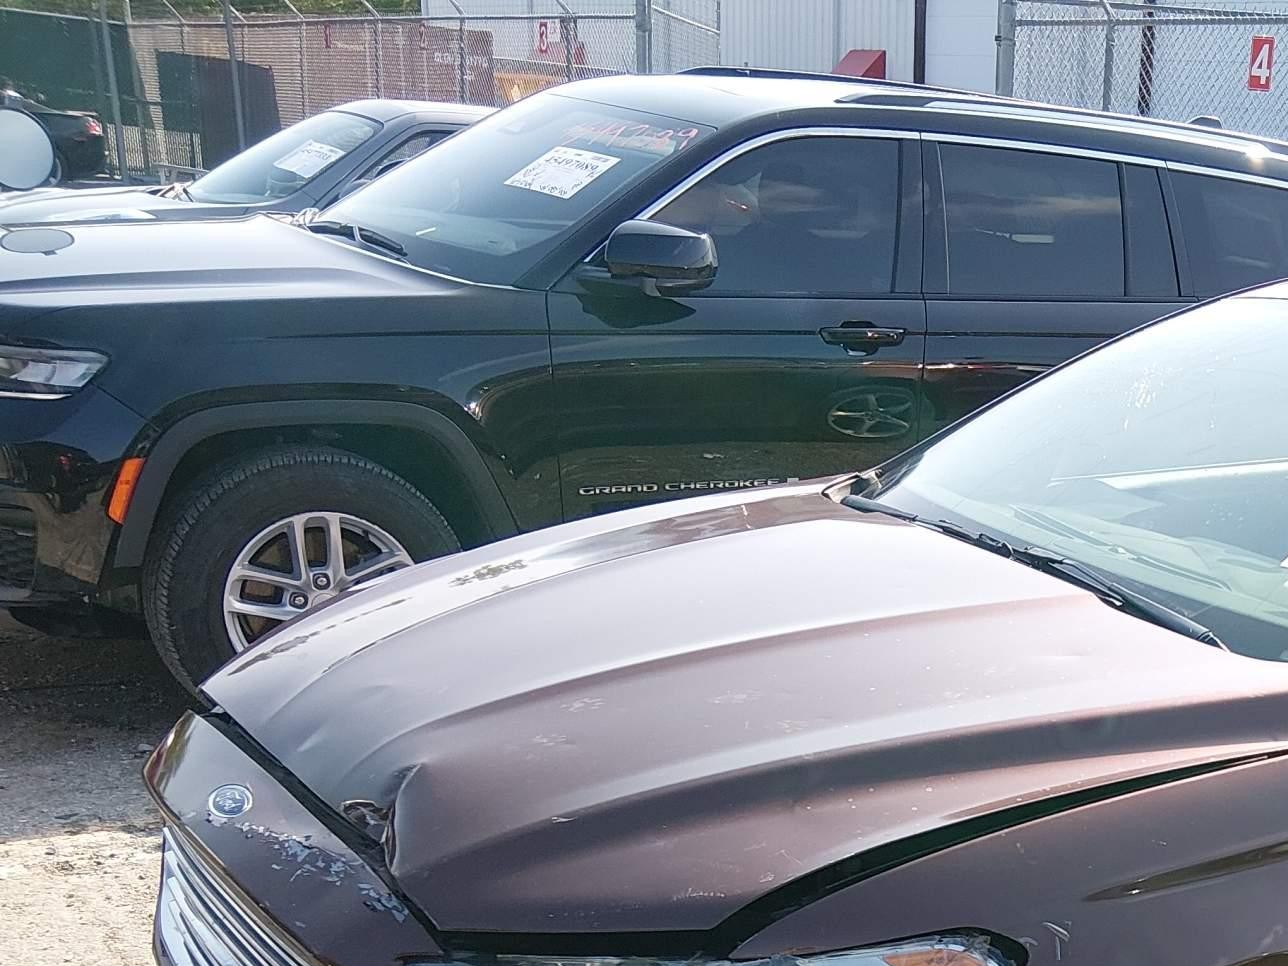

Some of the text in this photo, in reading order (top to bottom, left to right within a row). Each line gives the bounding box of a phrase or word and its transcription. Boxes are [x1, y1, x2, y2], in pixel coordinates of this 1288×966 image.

[540, 24, 547, 51] 3
[1251, 43, 1270, 85] 4
[578, 483, 658, 495] GRAND
[664, 478, 780, 491] CHEROKEE
